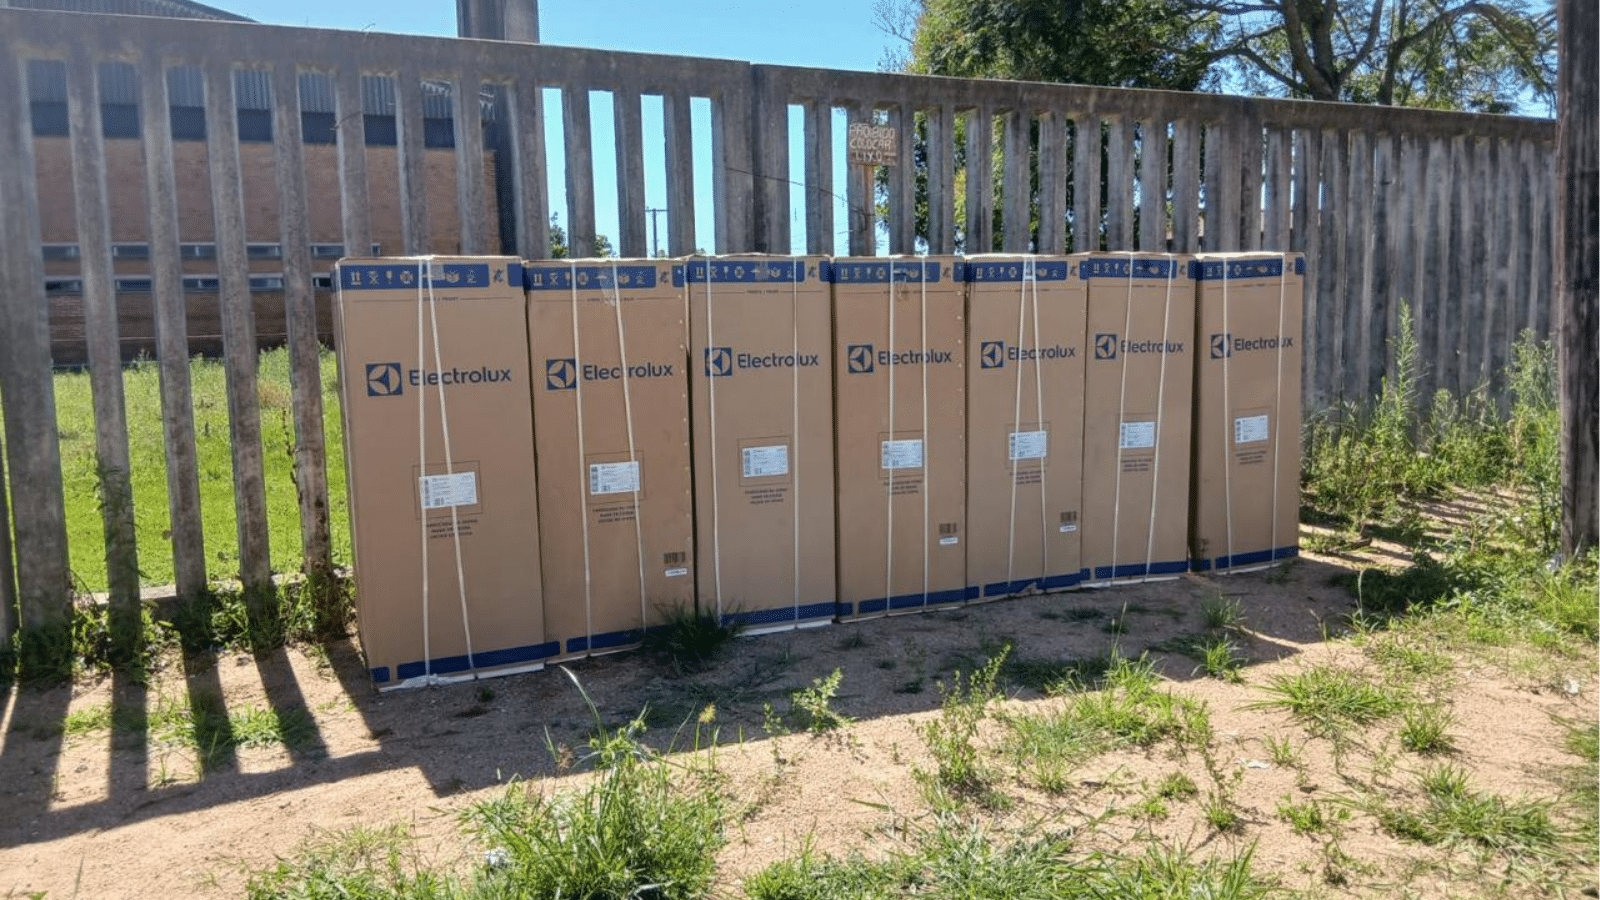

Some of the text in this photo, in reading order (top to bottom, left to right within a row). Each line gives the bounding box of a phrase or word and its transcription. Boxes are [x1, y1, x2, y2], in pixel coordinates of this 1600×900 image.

[849, 138, 892, 151] COLOCAR
[409, 367, 512, 386] Electrolux
[583, 362, 673, 380] Elecrolux
